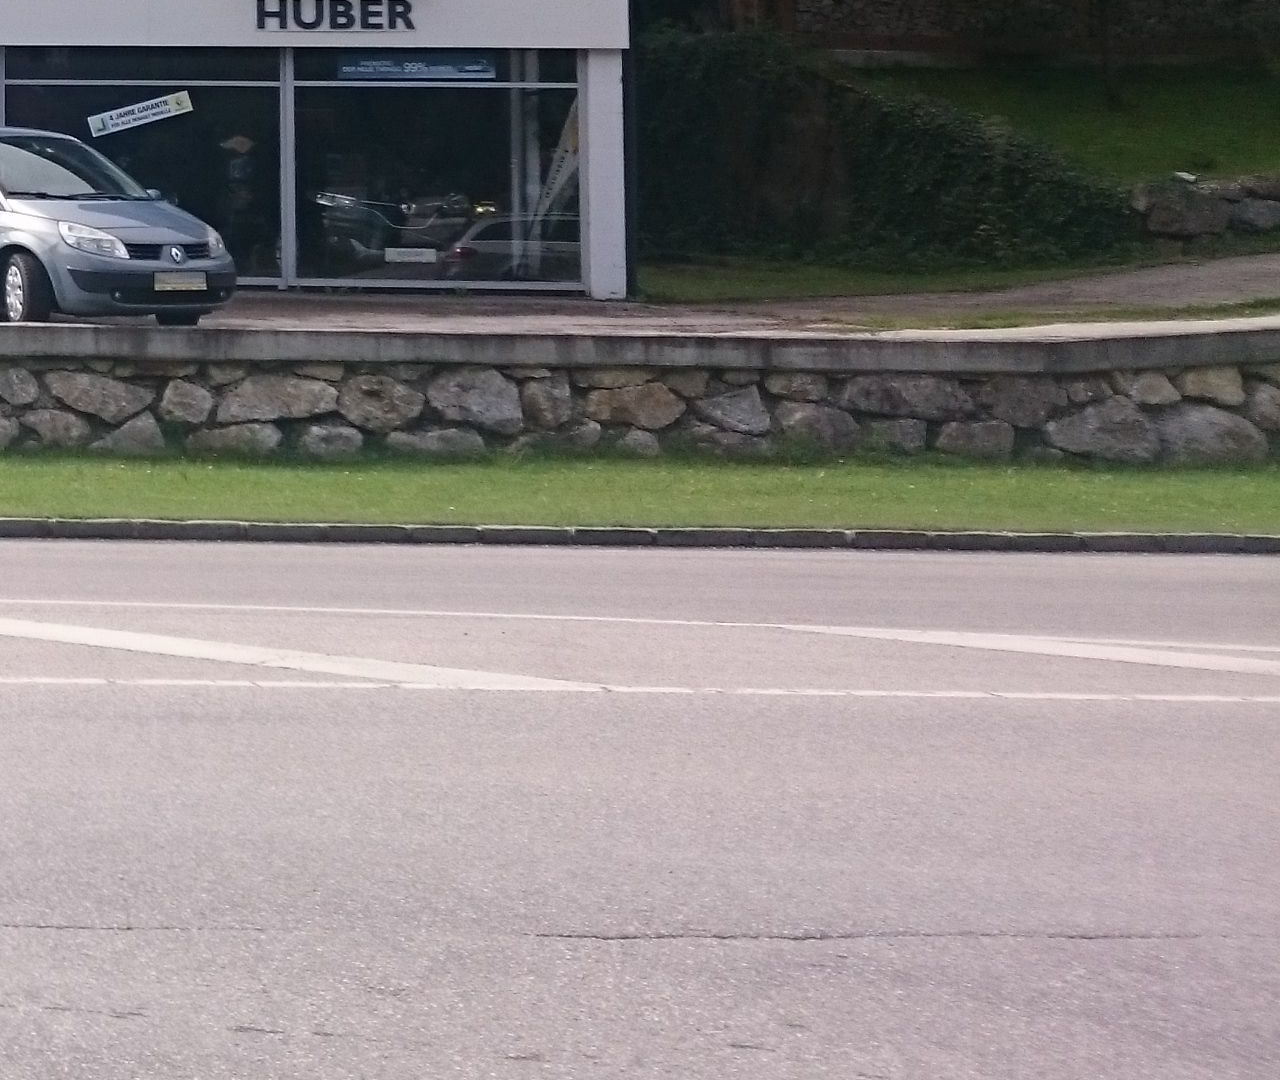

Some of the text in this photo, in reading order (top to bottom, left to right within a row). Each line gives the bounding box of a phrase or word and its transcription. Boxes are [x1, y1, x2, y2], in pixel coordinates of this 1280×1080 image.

[256, 0, 415, 30] HUBER
[116, 108, 136, 120] JAHRE
[137, 100, 169, 114] GARANTIE
